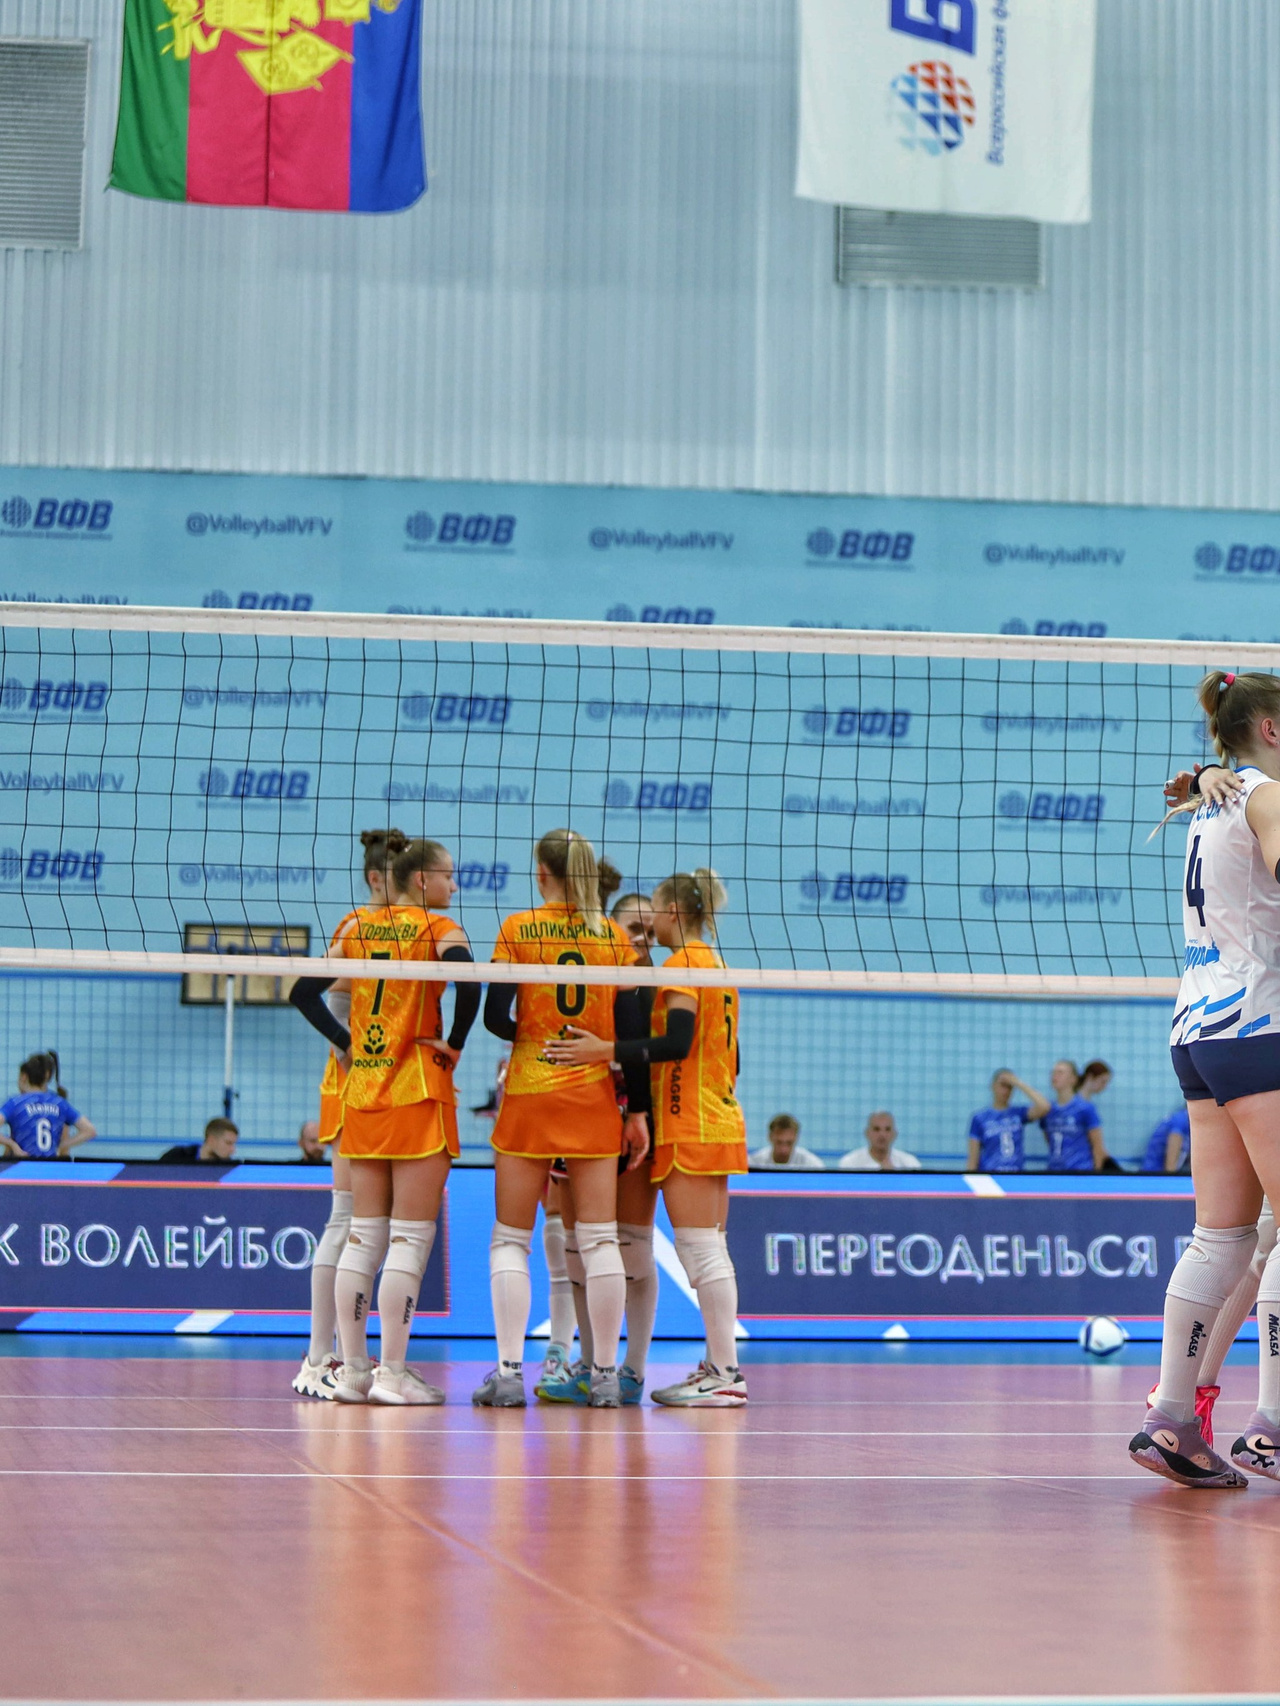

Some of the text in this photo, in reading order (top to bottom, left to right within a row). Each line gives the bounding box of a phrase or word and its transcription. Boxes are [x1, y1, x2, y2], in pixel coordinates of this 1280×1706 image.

[33, 498, 113, 531] ВФВ
[437, 512, 516, 545] ВФВ
[837, 528, 915, 562] ВФВ
[29, 679, 108, 712] ВФВ
[434, 692, 513, 725] ВФВ
[835, 707, 912, 739] ВФВ
[232, 768, 311, 799] ВФВ
[635, 781, 713, 811] ВФВ
[1030, 792, 1106, 822] ВФВ
[26, 849, 105, 881] ВФВ
[459, 861, 511, 892] ФВ
[1186, 834, 1206, 927] 4
[832, 873, 910, 904] ВФВ
[519, 922, 616, 940] ПОЛИКАРПВА
[371, 952, 391, 1015] 7
[36, 1117, 53, 1152] 6
[41, 1215, 319, 1271] ВОЛЕЙБО
[765, 1232, 1158, 1284] ПЕРЕОДЕНЬСЯ
[1187, 1321, 1207, 1358] MIKASA
